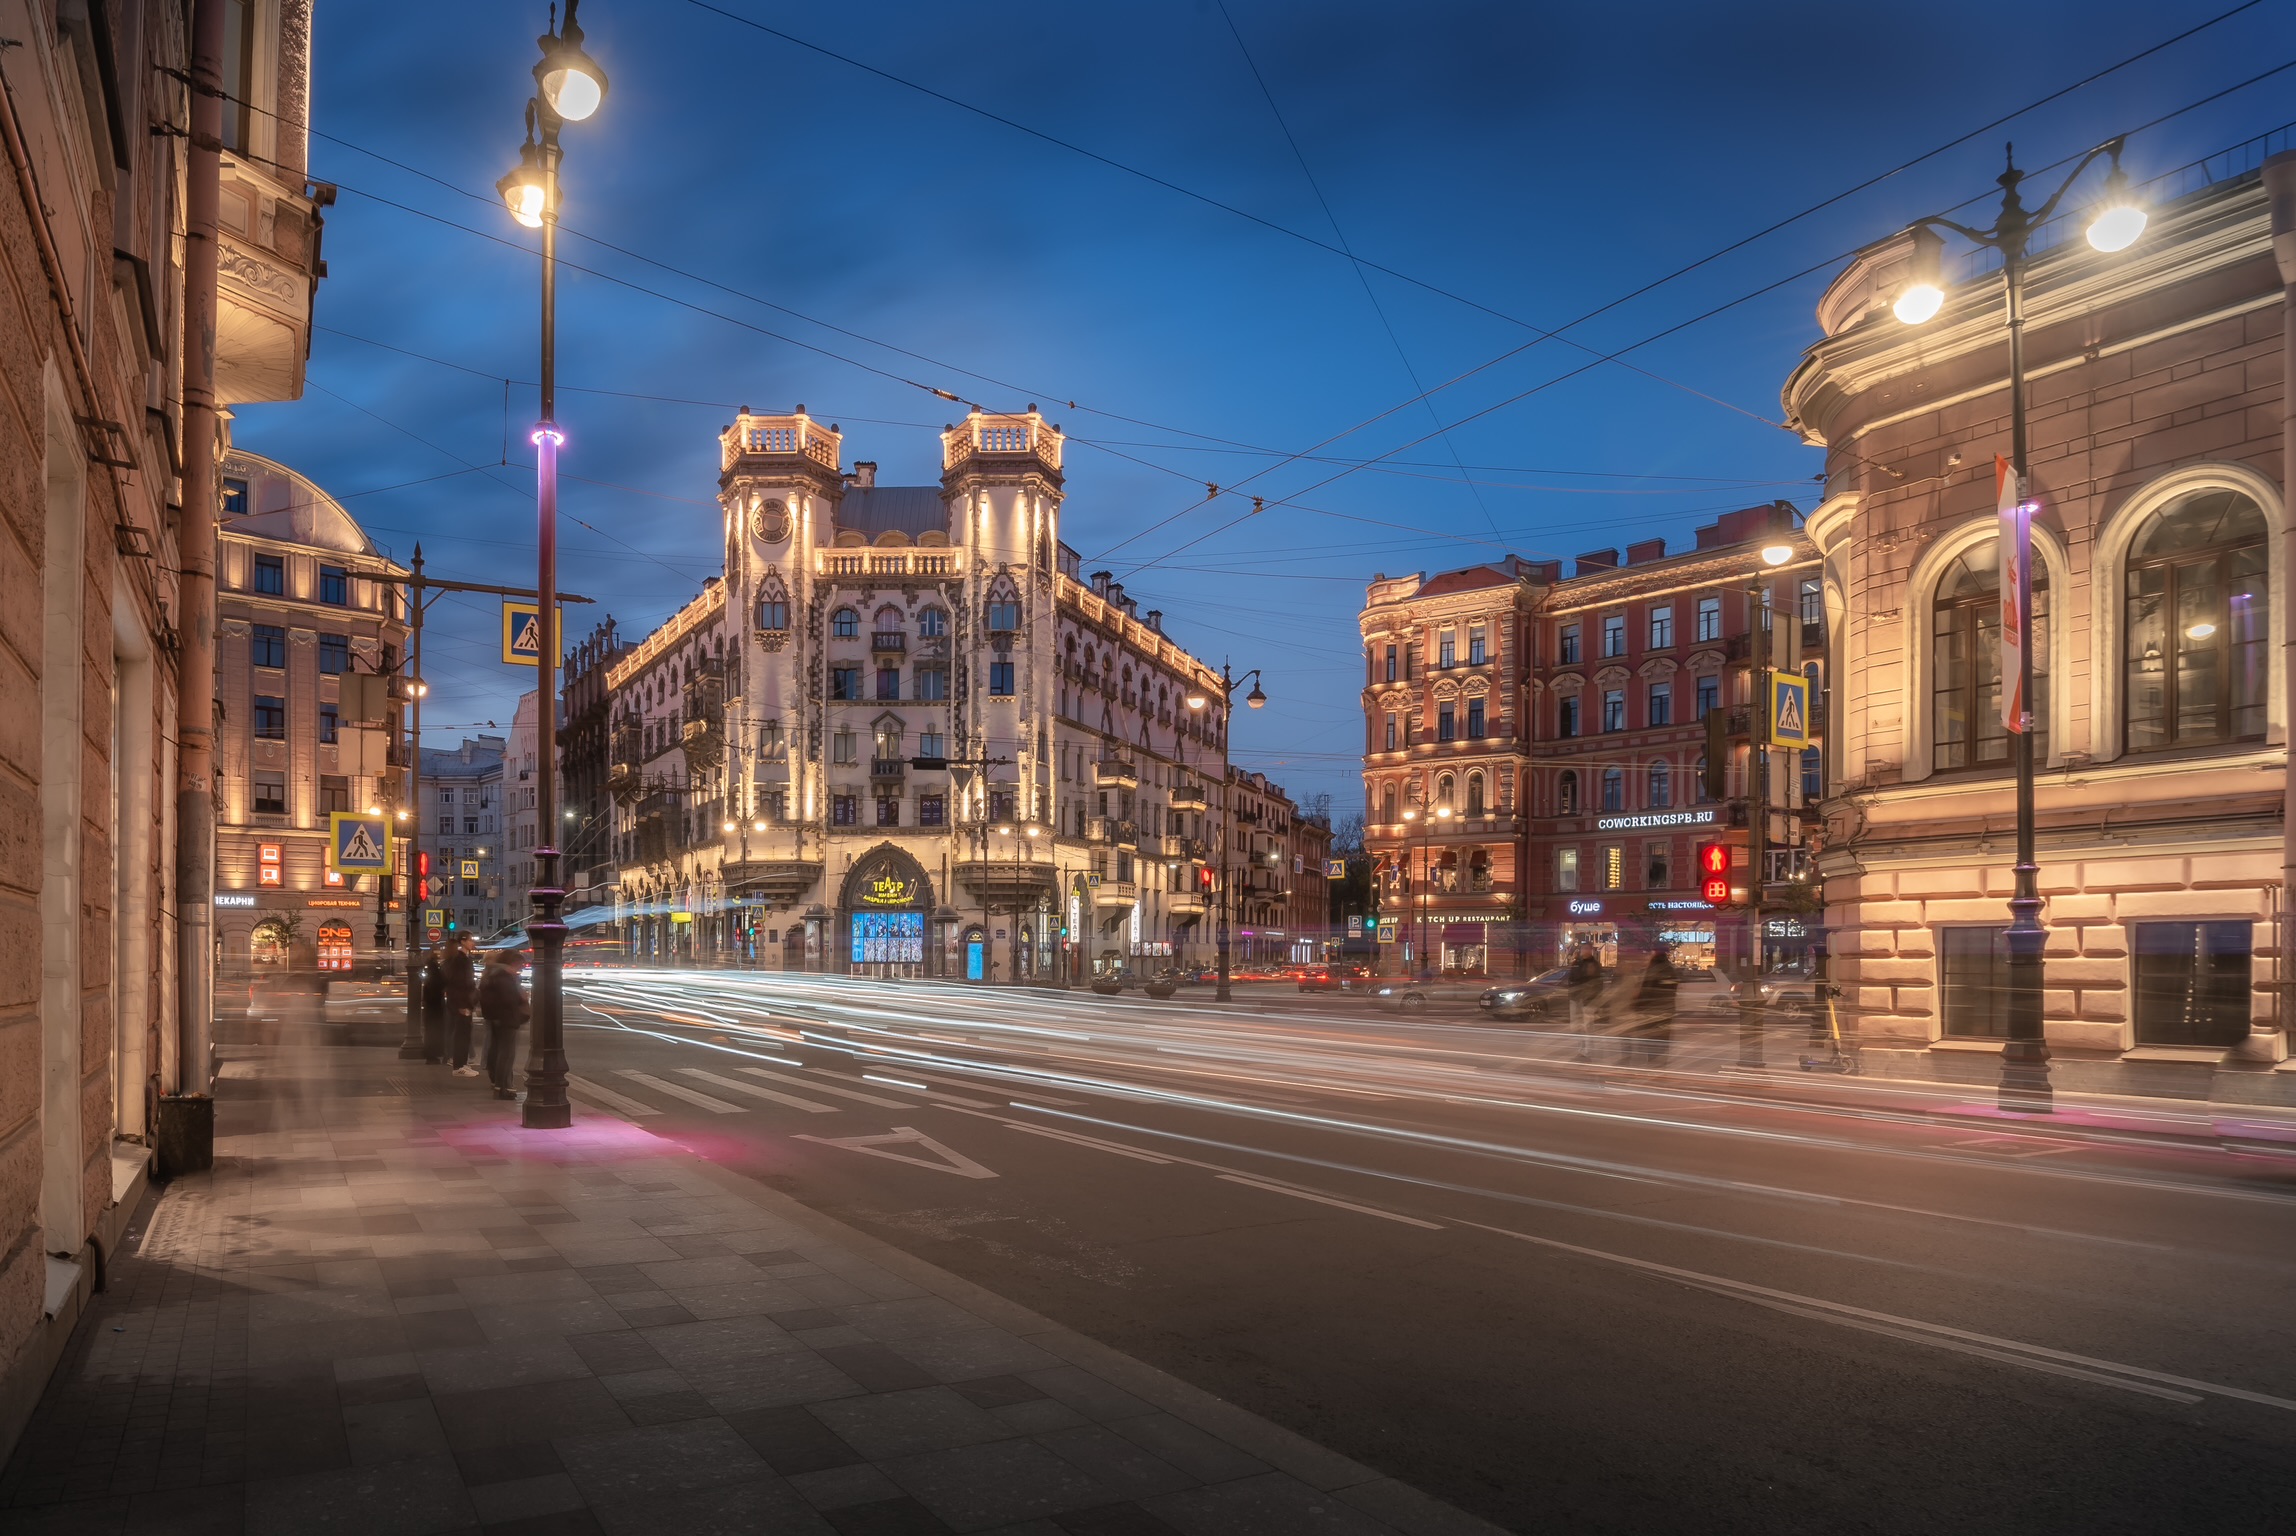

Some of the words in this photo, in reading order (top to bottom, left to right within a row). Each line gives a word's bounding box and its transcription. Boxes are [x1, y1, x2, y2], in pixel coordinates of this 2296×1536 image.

[1598, 811, 1714, 829] COWORKINGSPB.RU
[872, 876, 904, 892] ТЕАТР
[1570, 901, 1600, 914] буше
[318, 927, 352, 938] DNS
